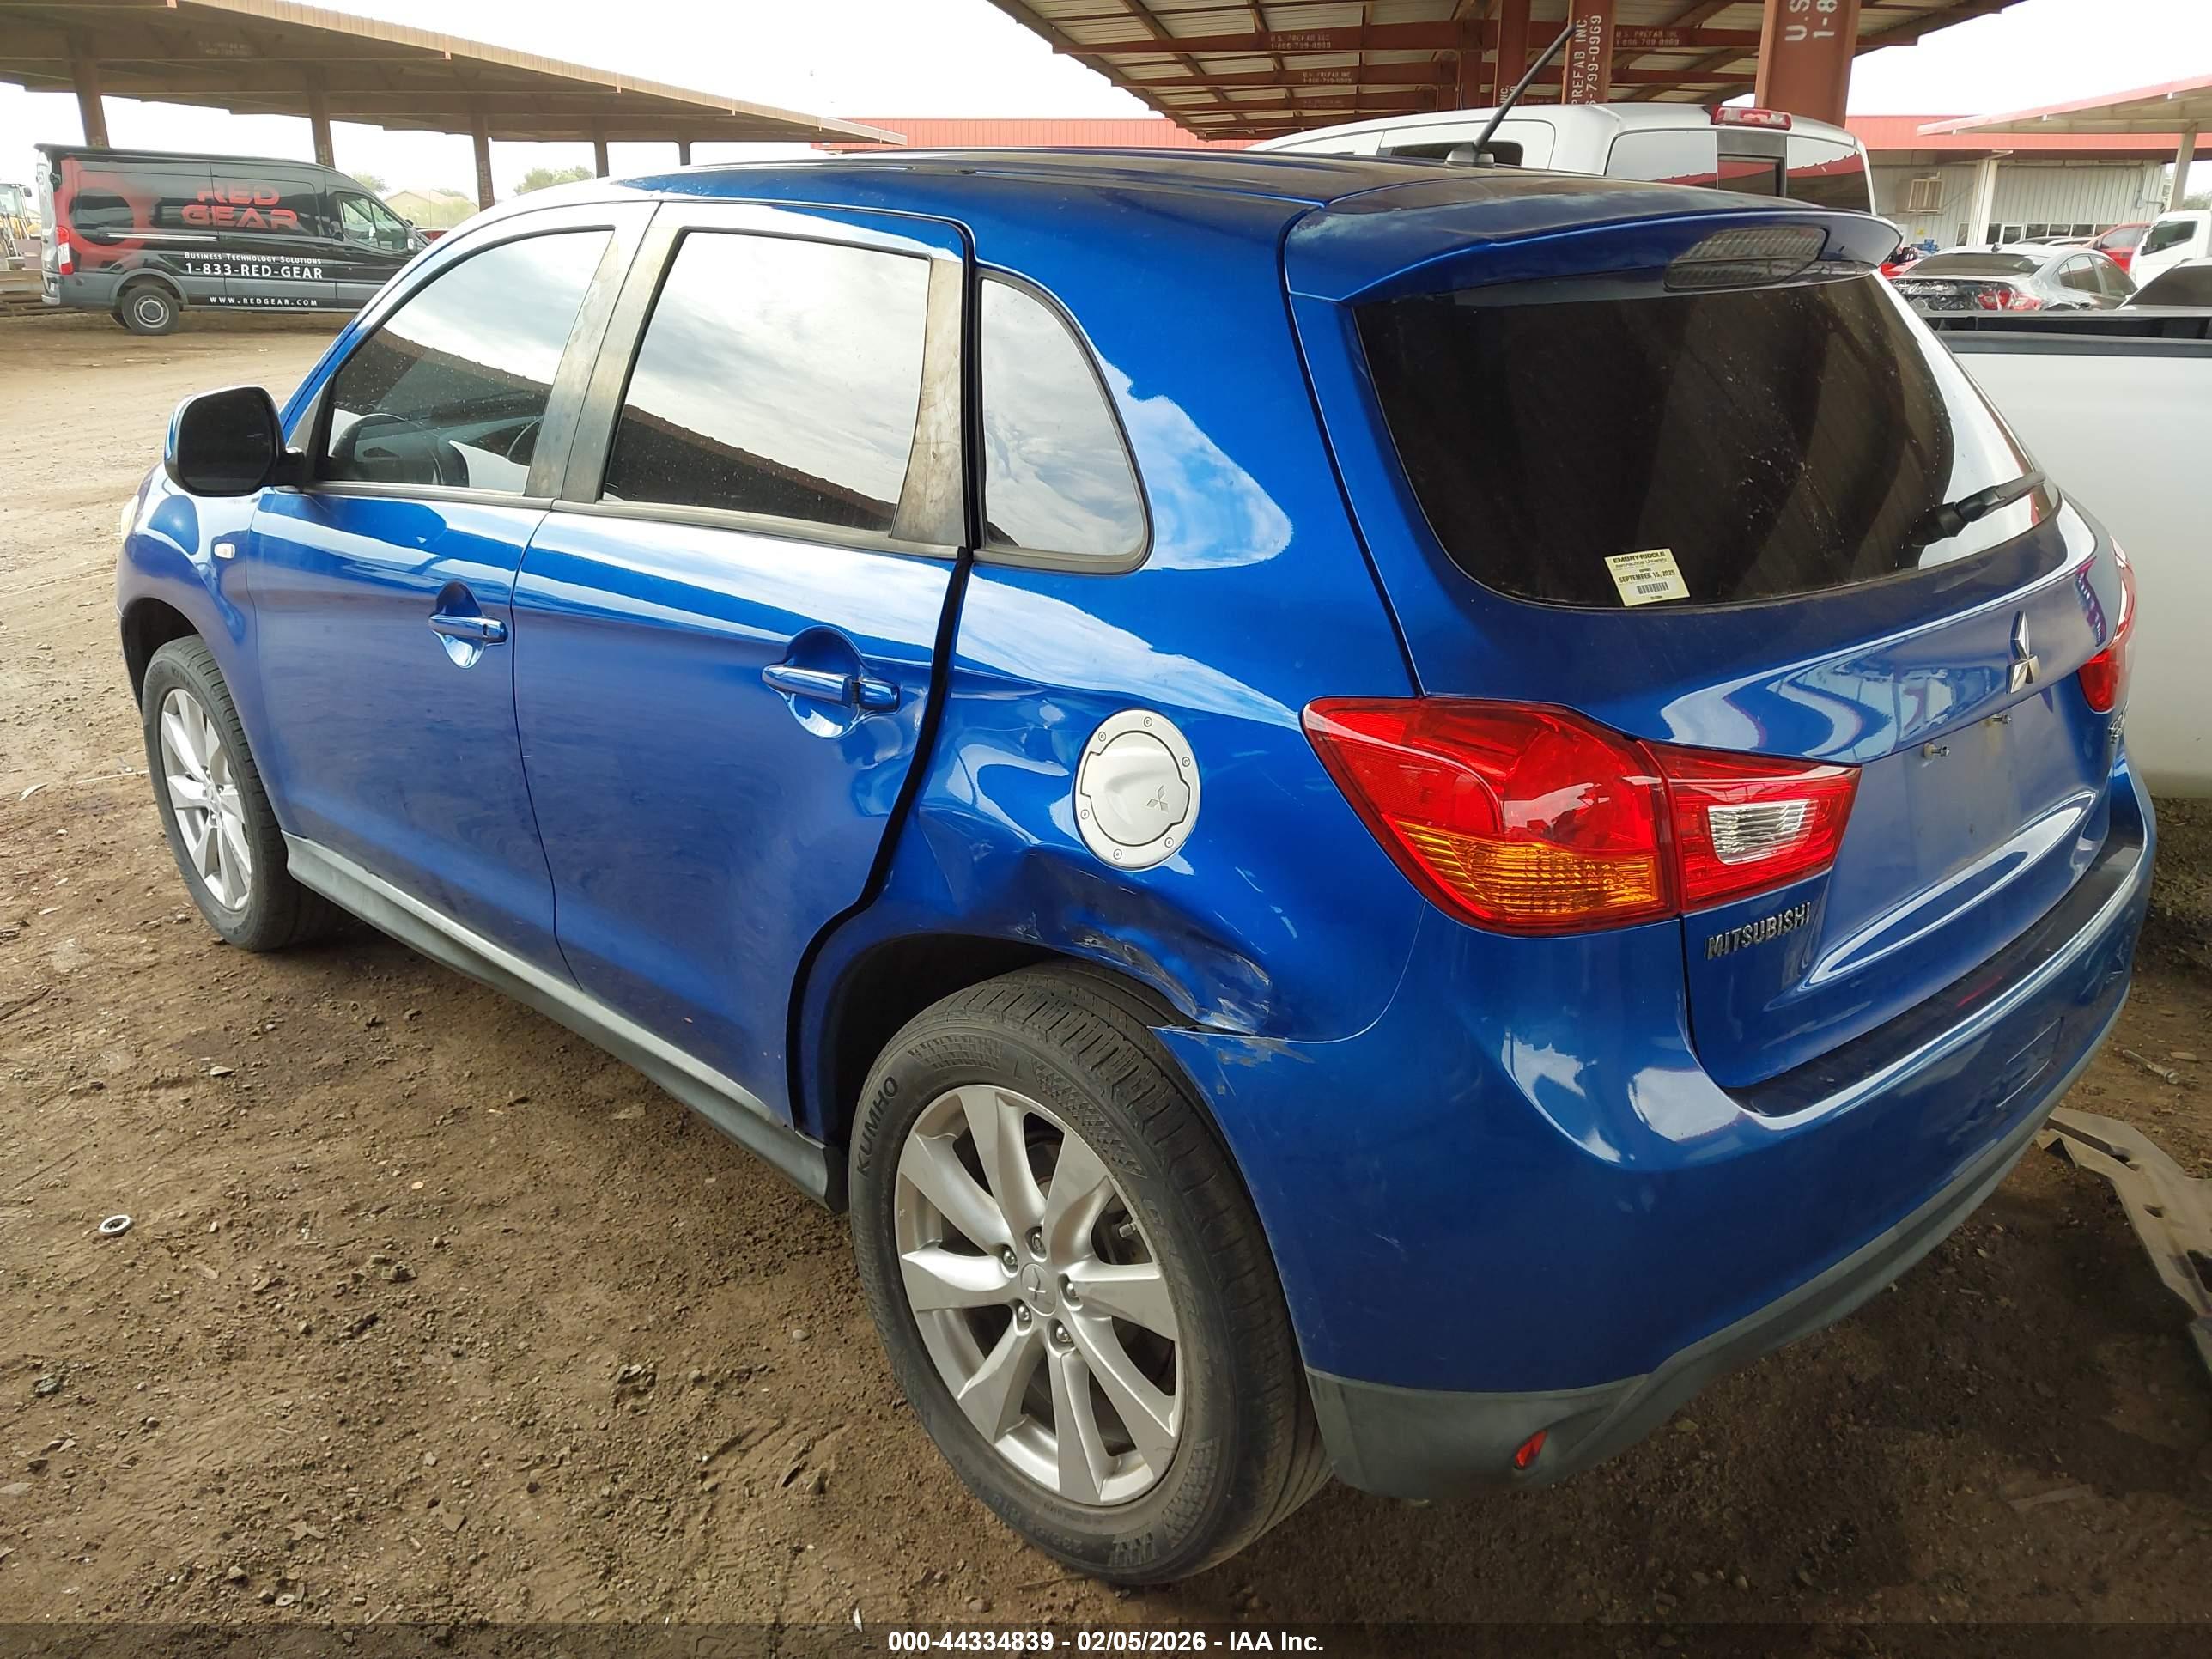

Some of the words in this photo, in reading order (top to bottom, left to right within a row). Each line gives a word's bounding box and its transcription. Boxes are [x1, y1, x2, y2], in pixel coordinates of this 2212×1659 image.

[1575, 14, 1589, 42] INC.
[196, 184, 280, 206] RED
[181, 204, 300, 231] GEAR
[185, 263, 323, 279] 1-833-RED-GEAR
[210, 296, 318, 306] WWW.REDGEAR.COM
[1619, 573, 1651, 583] SEPTEMBER
[1704, 902, 1811, 960] MITSUBISHI
[857, 1076, 898, 1177] KUMHO
